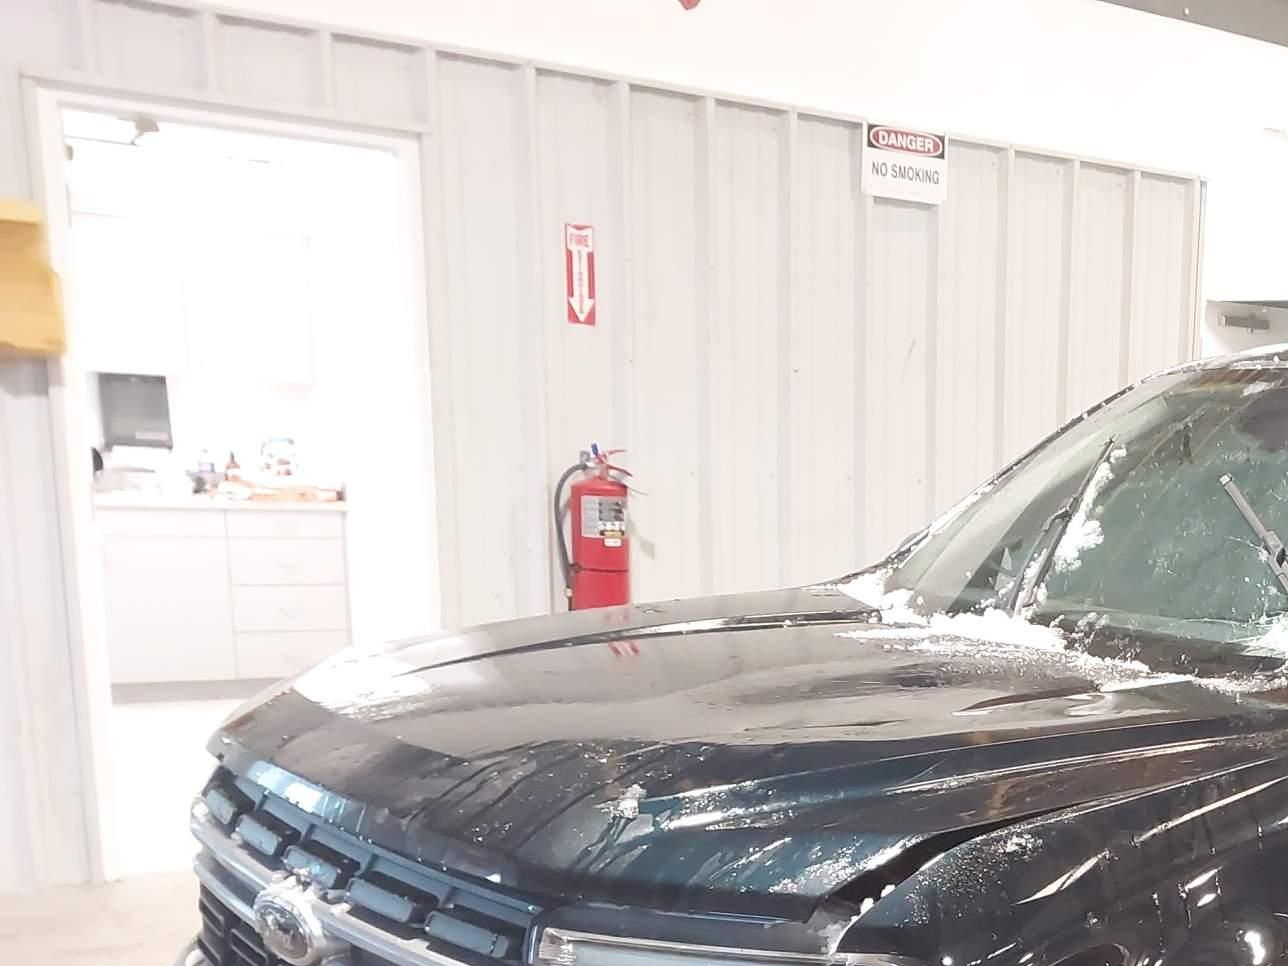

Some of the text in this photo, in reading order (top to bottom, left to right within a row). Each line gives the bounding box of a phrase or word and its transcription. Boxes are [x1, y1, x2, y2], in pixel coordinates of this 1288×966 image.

[878, 130, 934, 152] DANGER
[872, 161, 940, 184] NO SMOKING
